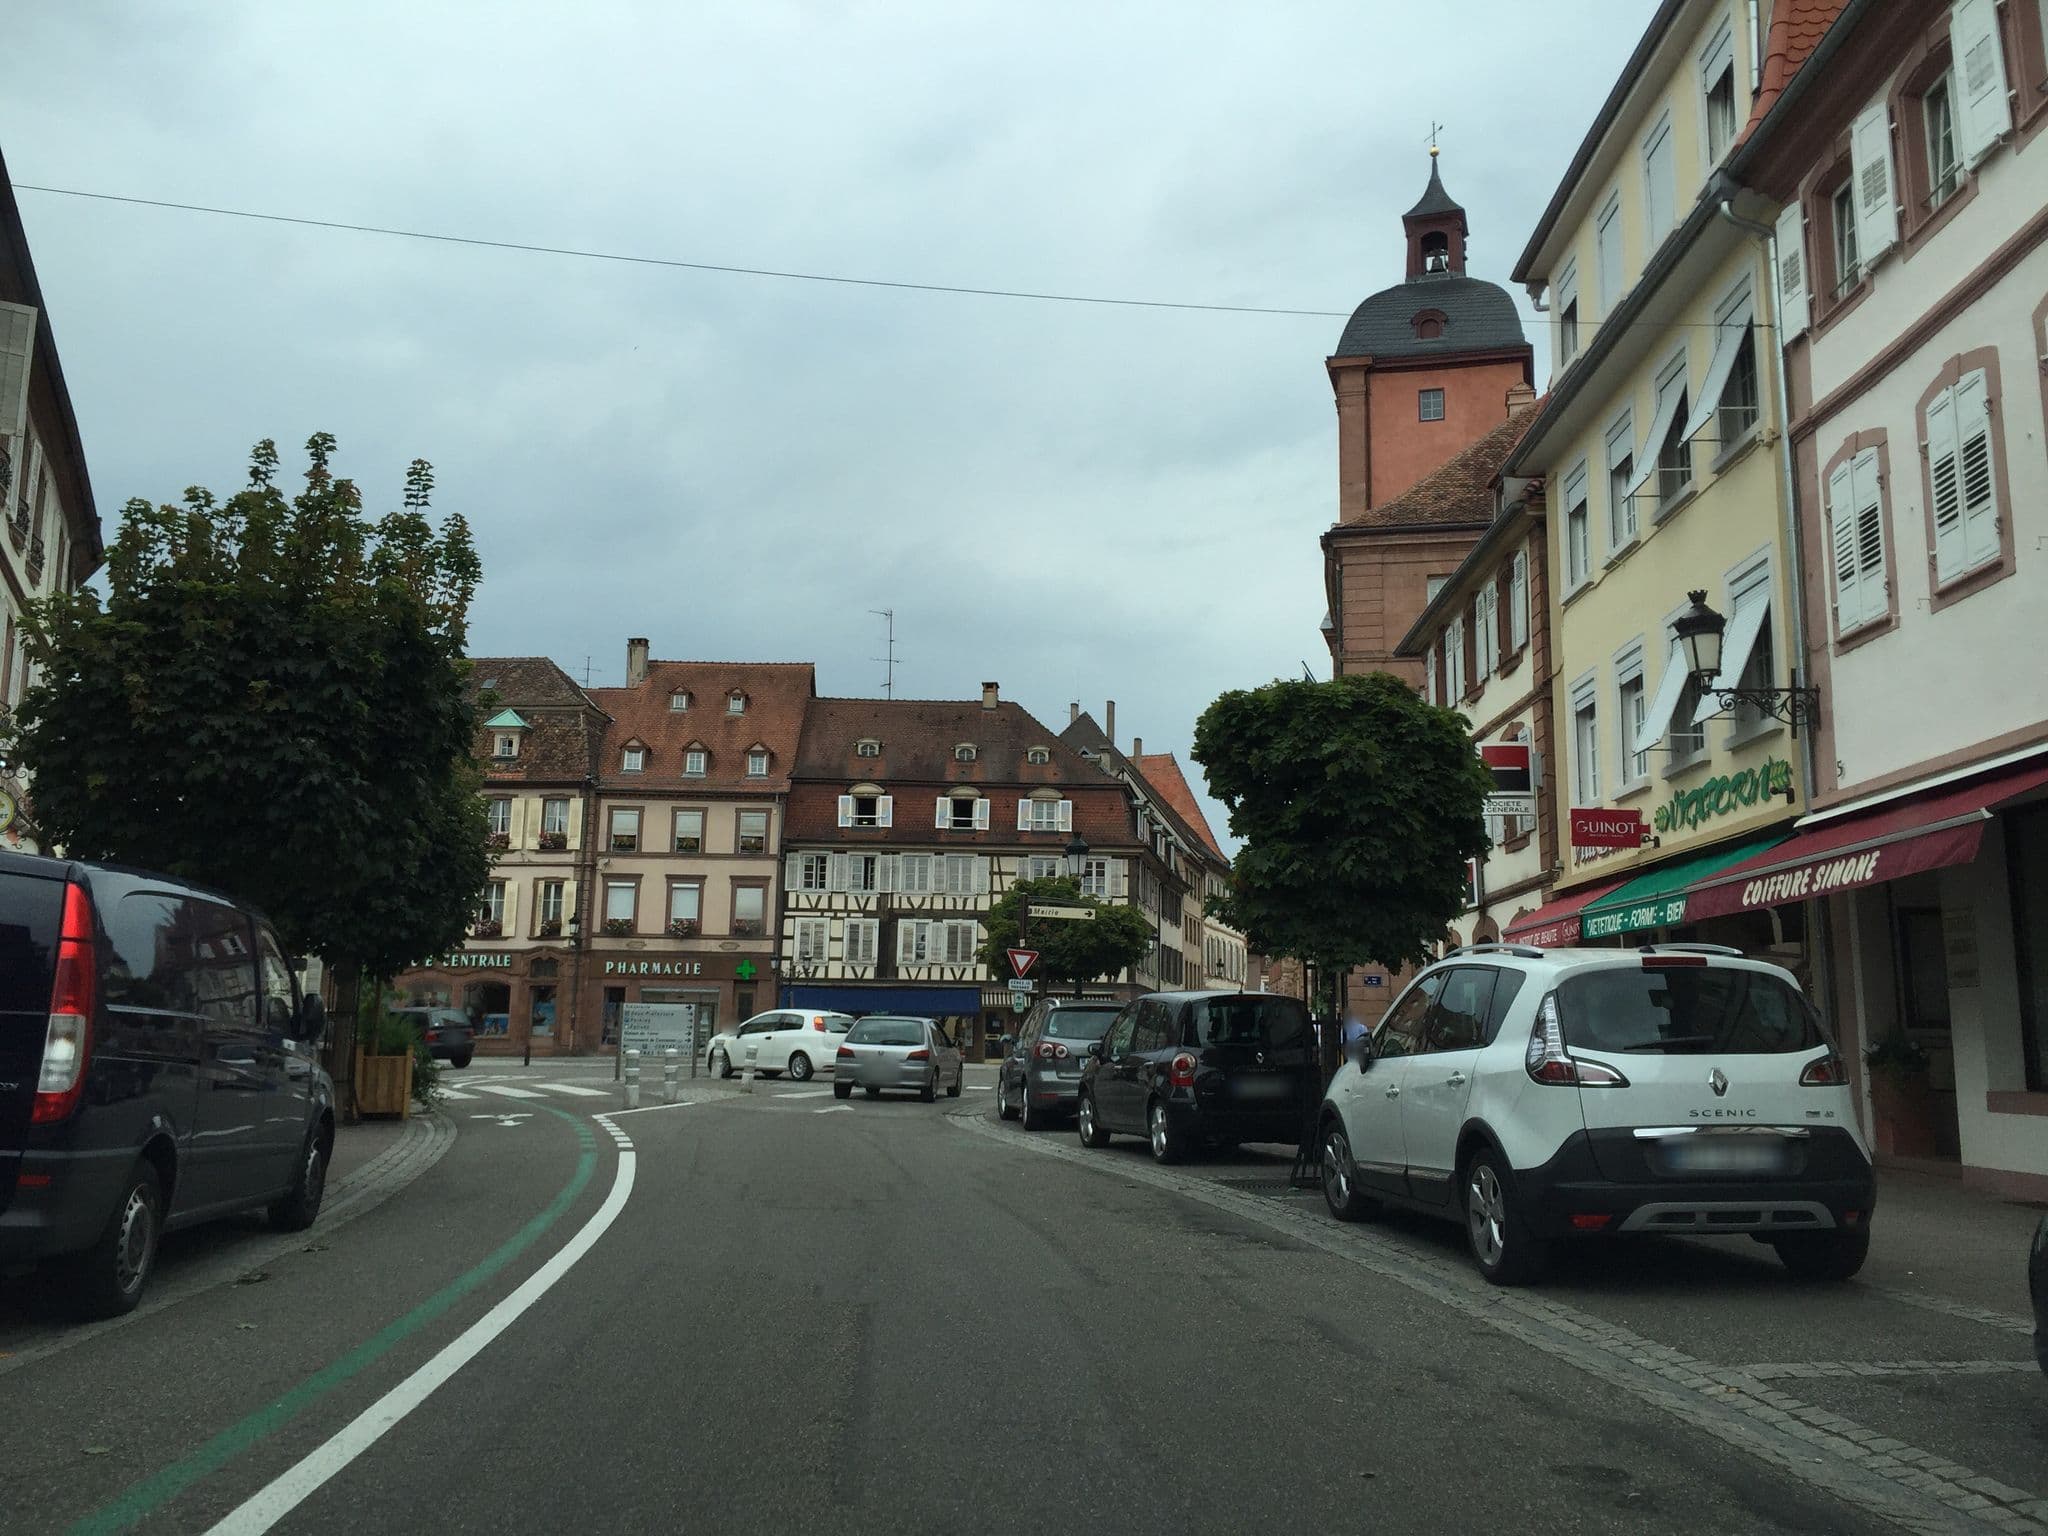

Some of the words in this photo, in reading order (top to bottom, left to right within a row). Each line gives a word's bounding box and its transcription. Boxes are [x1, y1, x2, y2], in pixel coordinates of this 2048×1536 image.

[1576, 820, 1637, 834] GUINOT
[1742, 867, 1812, 906] COIFFURE
[1812, 850, 1881, 892] SIMONE
[443, 954, 511, 967] CENTRALE
[605, 960, 701, 975] PHARMACIE
[1688, 1109, 1757, 1118] SCENIC
